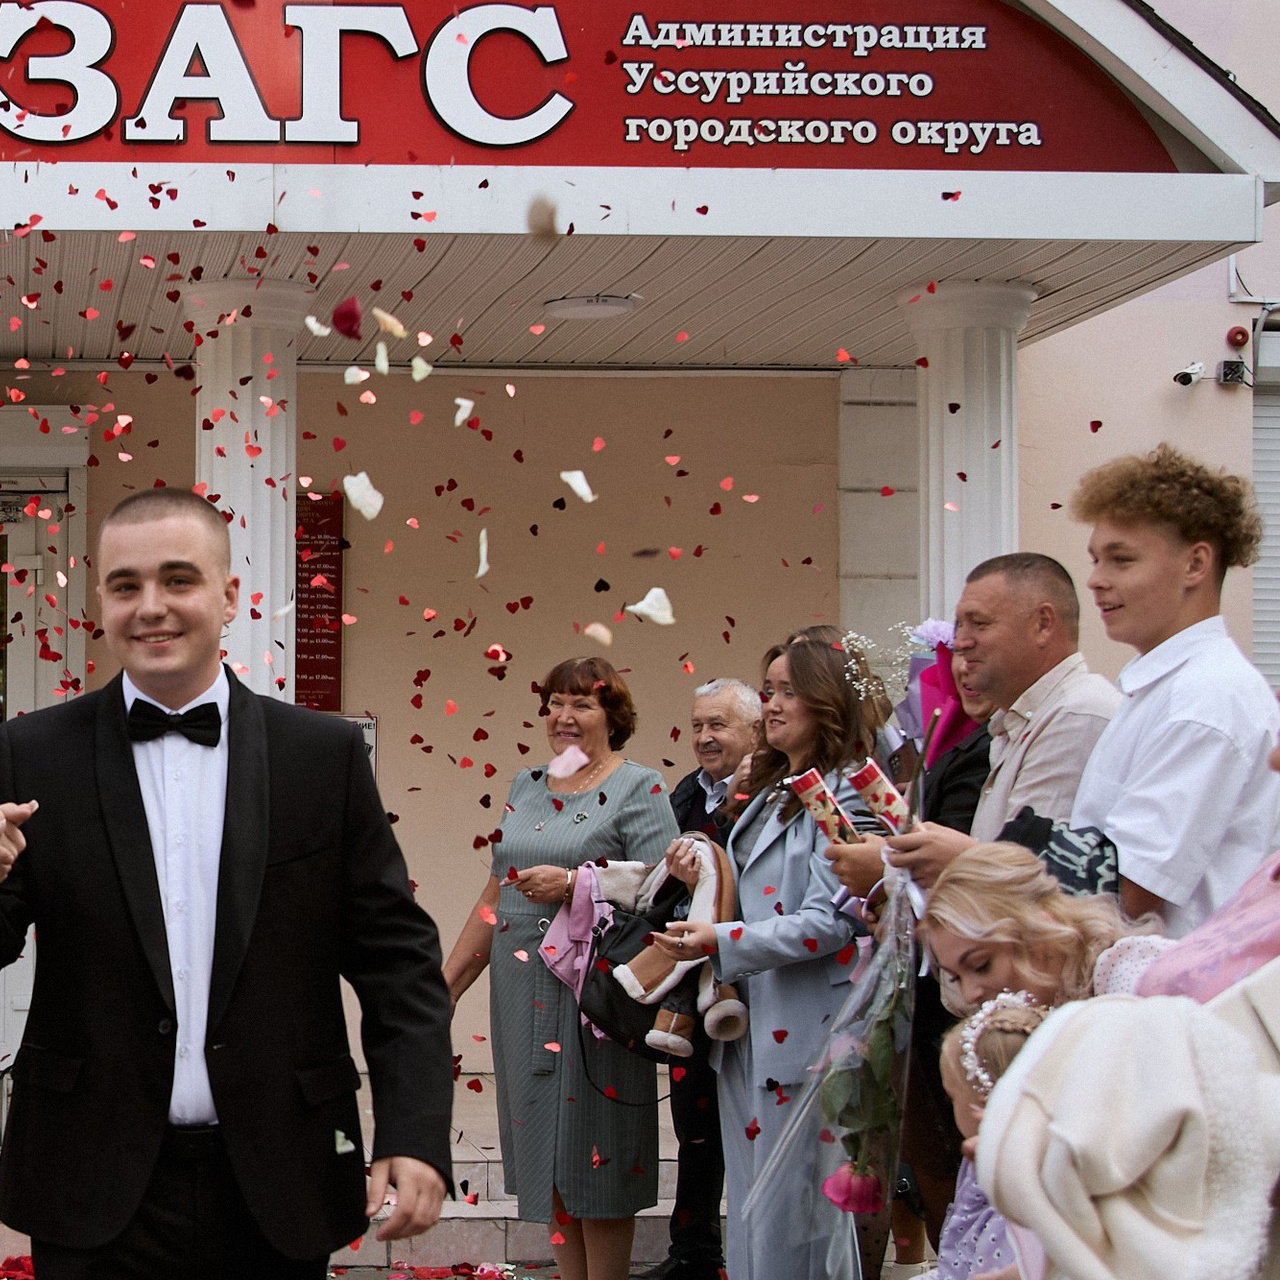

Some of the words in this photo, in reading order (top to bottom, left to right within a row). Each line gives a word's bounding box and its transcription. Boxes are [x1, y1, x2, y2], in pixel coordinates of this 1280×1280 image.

[622, 15, 987, 56] Администрация
[622, 61, 934, 103] Уссурийского
[624, 118, 878, 150] городского
[891, 120, 1043, 153] округа
